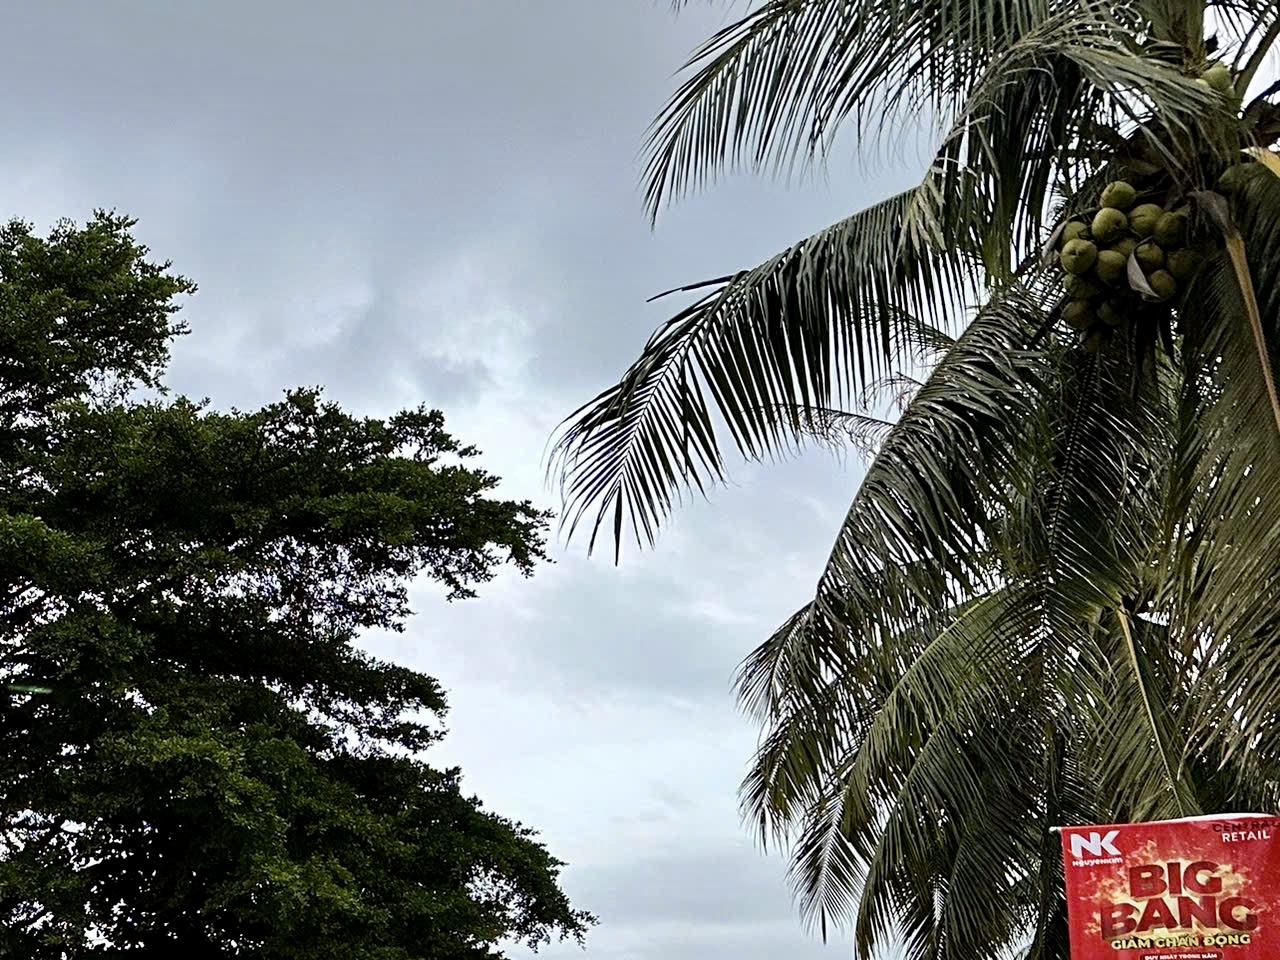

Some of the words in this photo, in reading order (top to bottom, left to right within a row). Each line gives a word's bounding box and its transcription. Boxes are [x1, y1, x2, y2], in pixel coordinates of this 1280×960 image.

[1070, 830, 1122, 859] NK
[1222, 829, 1271, 843] RETAIL
[1129, 860, 1222, 899] BIG
[1100, 895, 1258, 940] BANG
